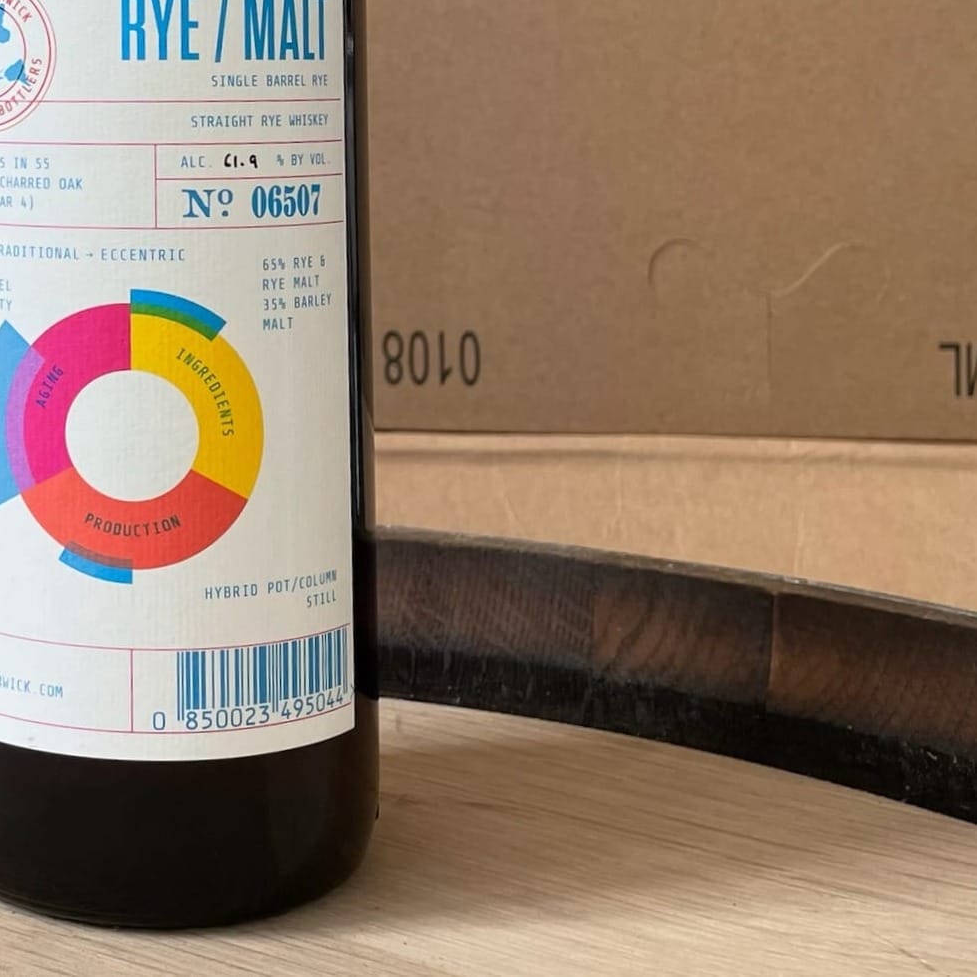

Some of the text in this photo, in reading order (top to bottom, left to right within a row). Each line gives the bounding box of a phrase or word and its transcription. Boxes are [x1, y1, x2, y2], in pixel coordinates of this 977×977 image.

[211, 74, 328, 87] SINGLE BARREL RYE
[191, 113, 329, 128] STRAIGHT RYE WHISKEY
[14, 157, 27, 169] IN
[35, 157, 50, 169] 55
[181, 155, 213, 168] ALC.
[291, 153, 304, 166] BY
[0, 176, 51, 190] CHARRED
[59, 177, 83, 190] OAK
[251, 183, 321, 219] 06507
[101, 248, 186, 262] ECCENTRIC
[263, 257, 285, 271] 65%
[293, 255, 313, 269] RYE
[263, 275, 319, 291] RYE MALT
[263, 293, 331, 311] 35% BARLEY
[263, 317, 293, 331] MALT
[383, 329, 482, 387] 0108
[35, 364, 64, 409] AGING
[175, 347, 235, 437] INGREDIENTS
[85, 513, 182, 537] PRODUCTION
[205, 569, 337, 599] HYBRID POT/COLUMN
[307, 590, 337, 608] STILL
[185, 705, 271, 731] 850023
[281, 687, 343, 719] 495044
